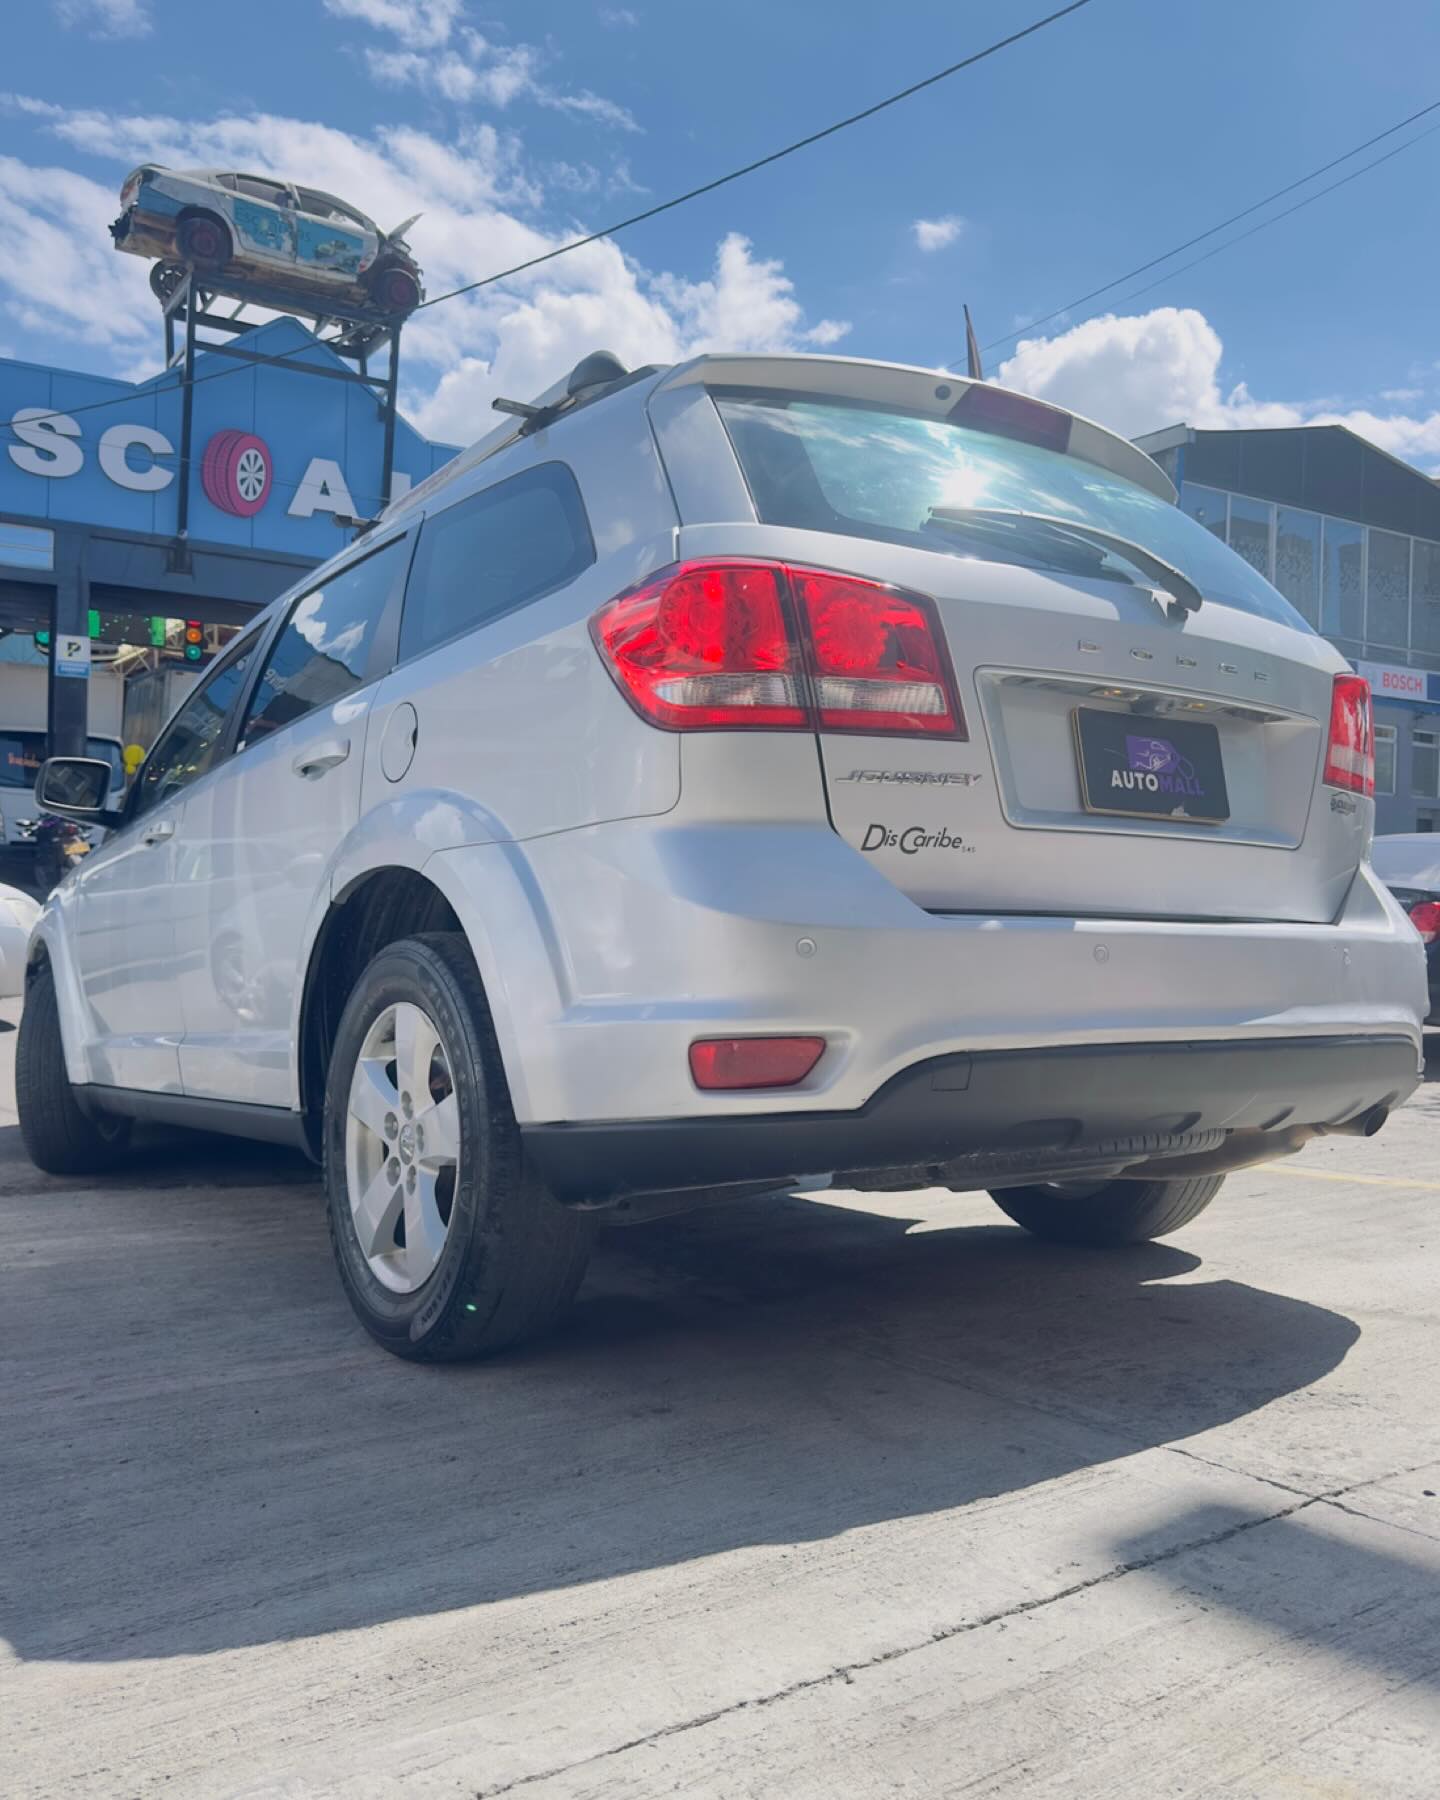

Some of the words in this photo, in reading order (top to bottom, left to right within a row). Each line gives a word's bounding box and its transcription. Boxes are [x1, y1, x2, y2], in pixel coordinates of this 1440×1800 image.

[1078, 639, 1271, 681] DODGE
[1382, 672, 1423, 693] BOSCH
[835, 769, 982, 787] JOURNEY
